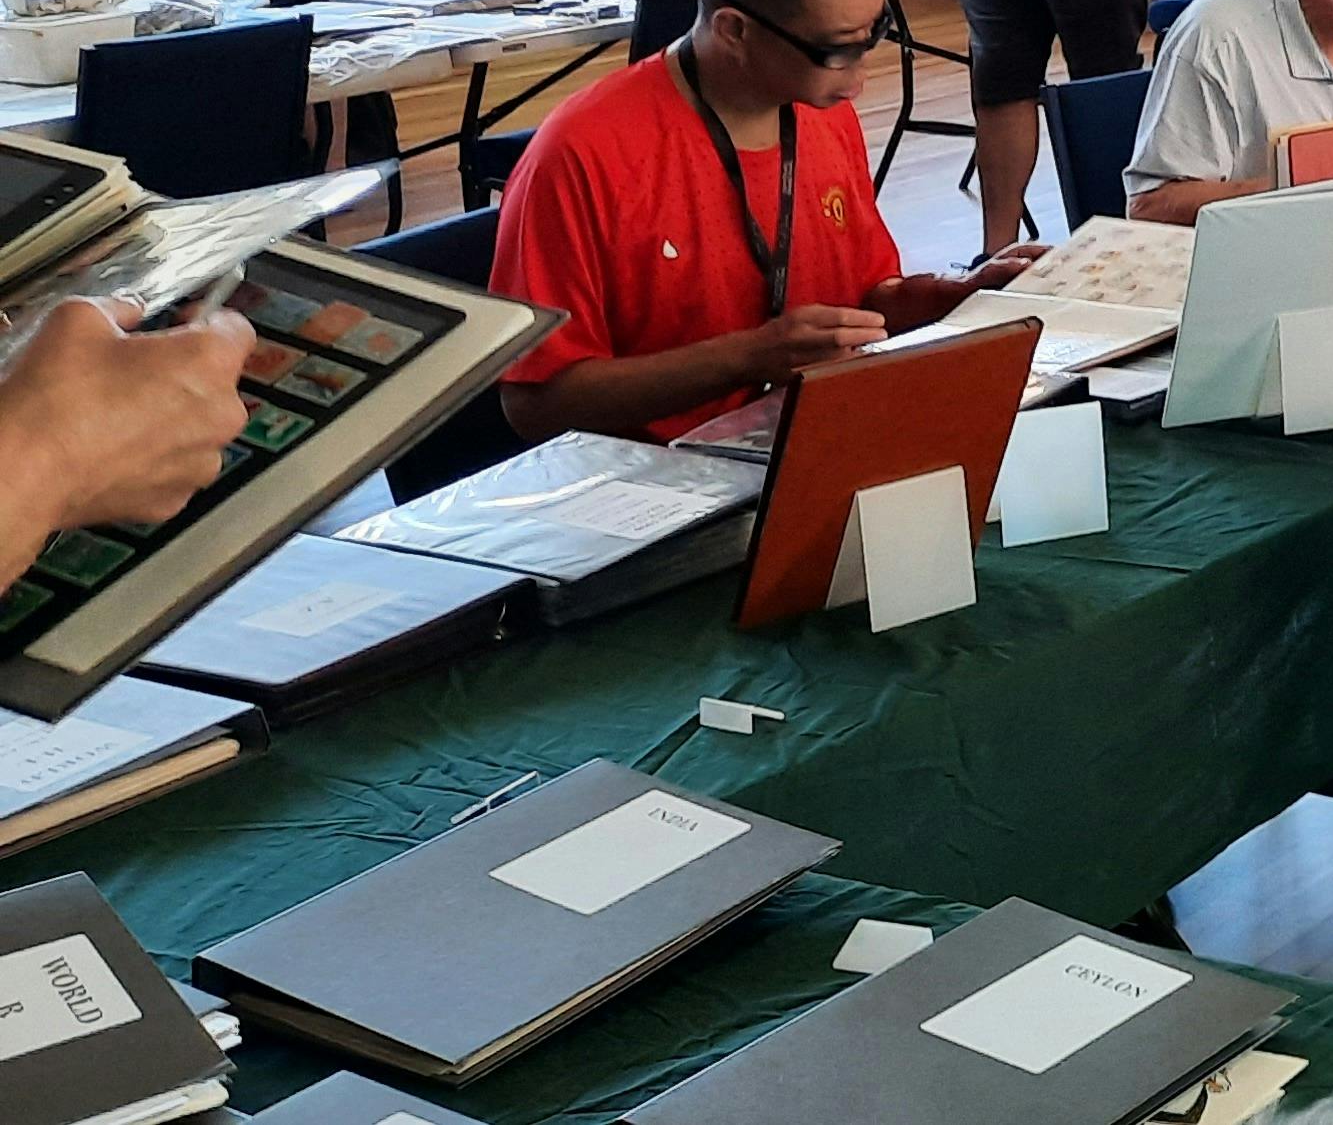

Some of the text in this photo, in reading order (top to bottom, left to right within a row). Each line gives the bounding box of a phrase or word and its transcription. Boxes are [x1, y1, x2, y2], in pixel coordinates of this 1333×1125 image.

[648, 807, 698, 831] INDIA
[40, 955, 103, 1024] WORLD
[1065, 964, 1147, 997] CEYLON
